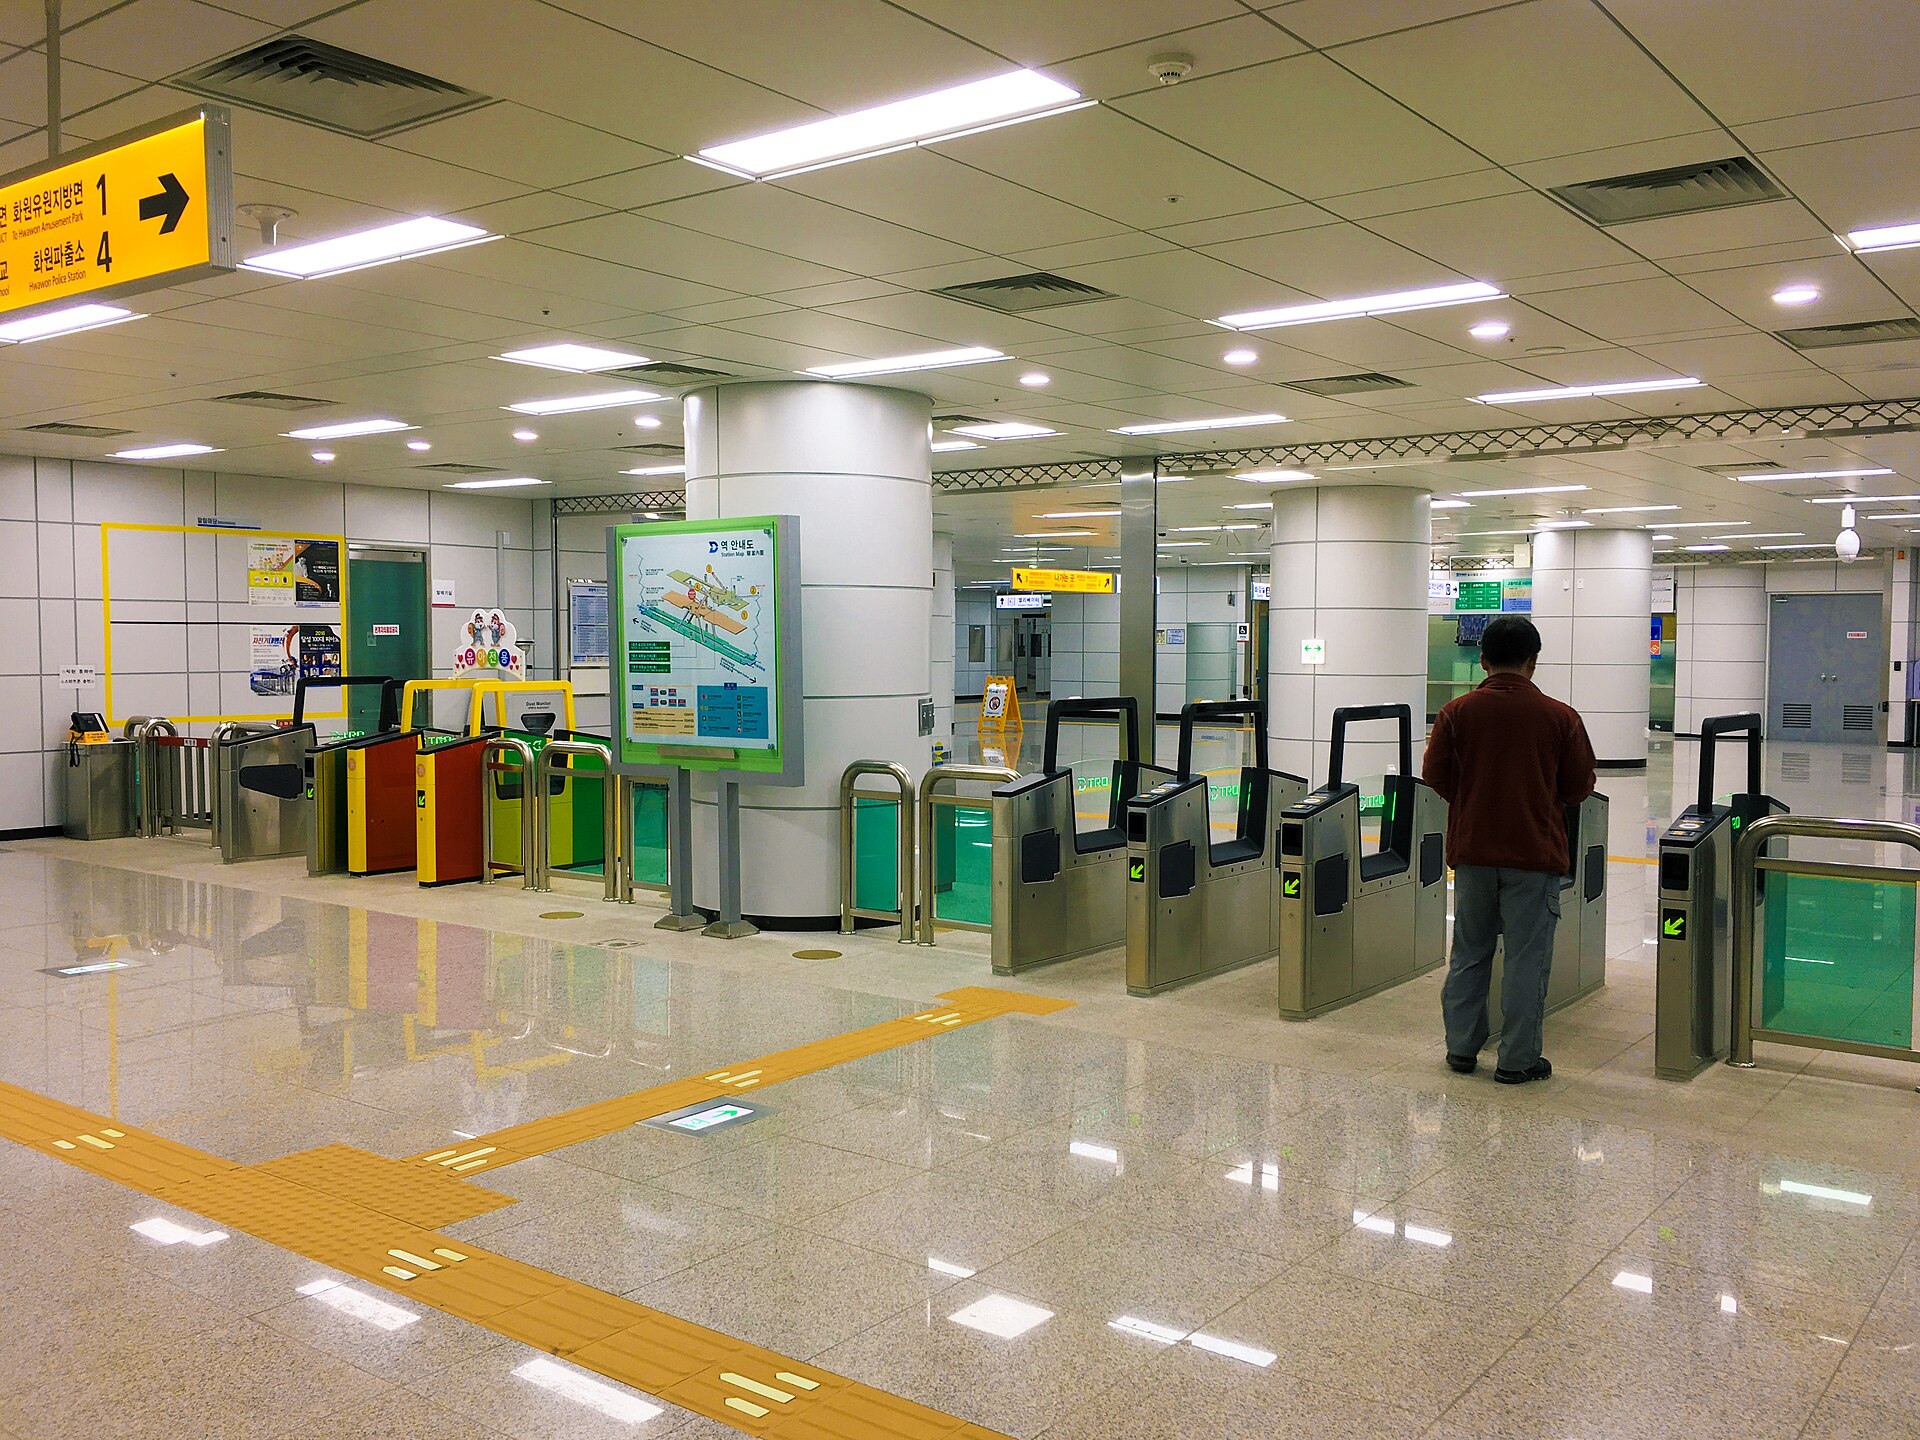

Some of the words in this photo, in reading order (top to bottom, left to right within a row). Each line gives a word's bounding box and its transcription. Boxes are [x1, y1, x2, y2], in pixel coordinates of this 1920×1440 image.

[13, 180, 84, 223] 화원유원지방면
[96, 173, 107, 216] 1
[12, 229, 18, 240] To
[18, 225, 41, 239] Hwawon
[41, 213, 72, 232] Amusement
[71, 210, 84, 223] Park
[33, 239, 86, 274] 화원파출소
[96, 230, 113, 273] 4
[28, 279, 52, 292] Hwawon
[51, 273, 67, 286] Police
[67, 269, 86, 283] Station
[720, 540, 728, 551] 역
[730, 539, 755, 551] 안내도
[1054, 573, 1069, 582] 나가는
[465, 650, 509, 665] 유아전용
